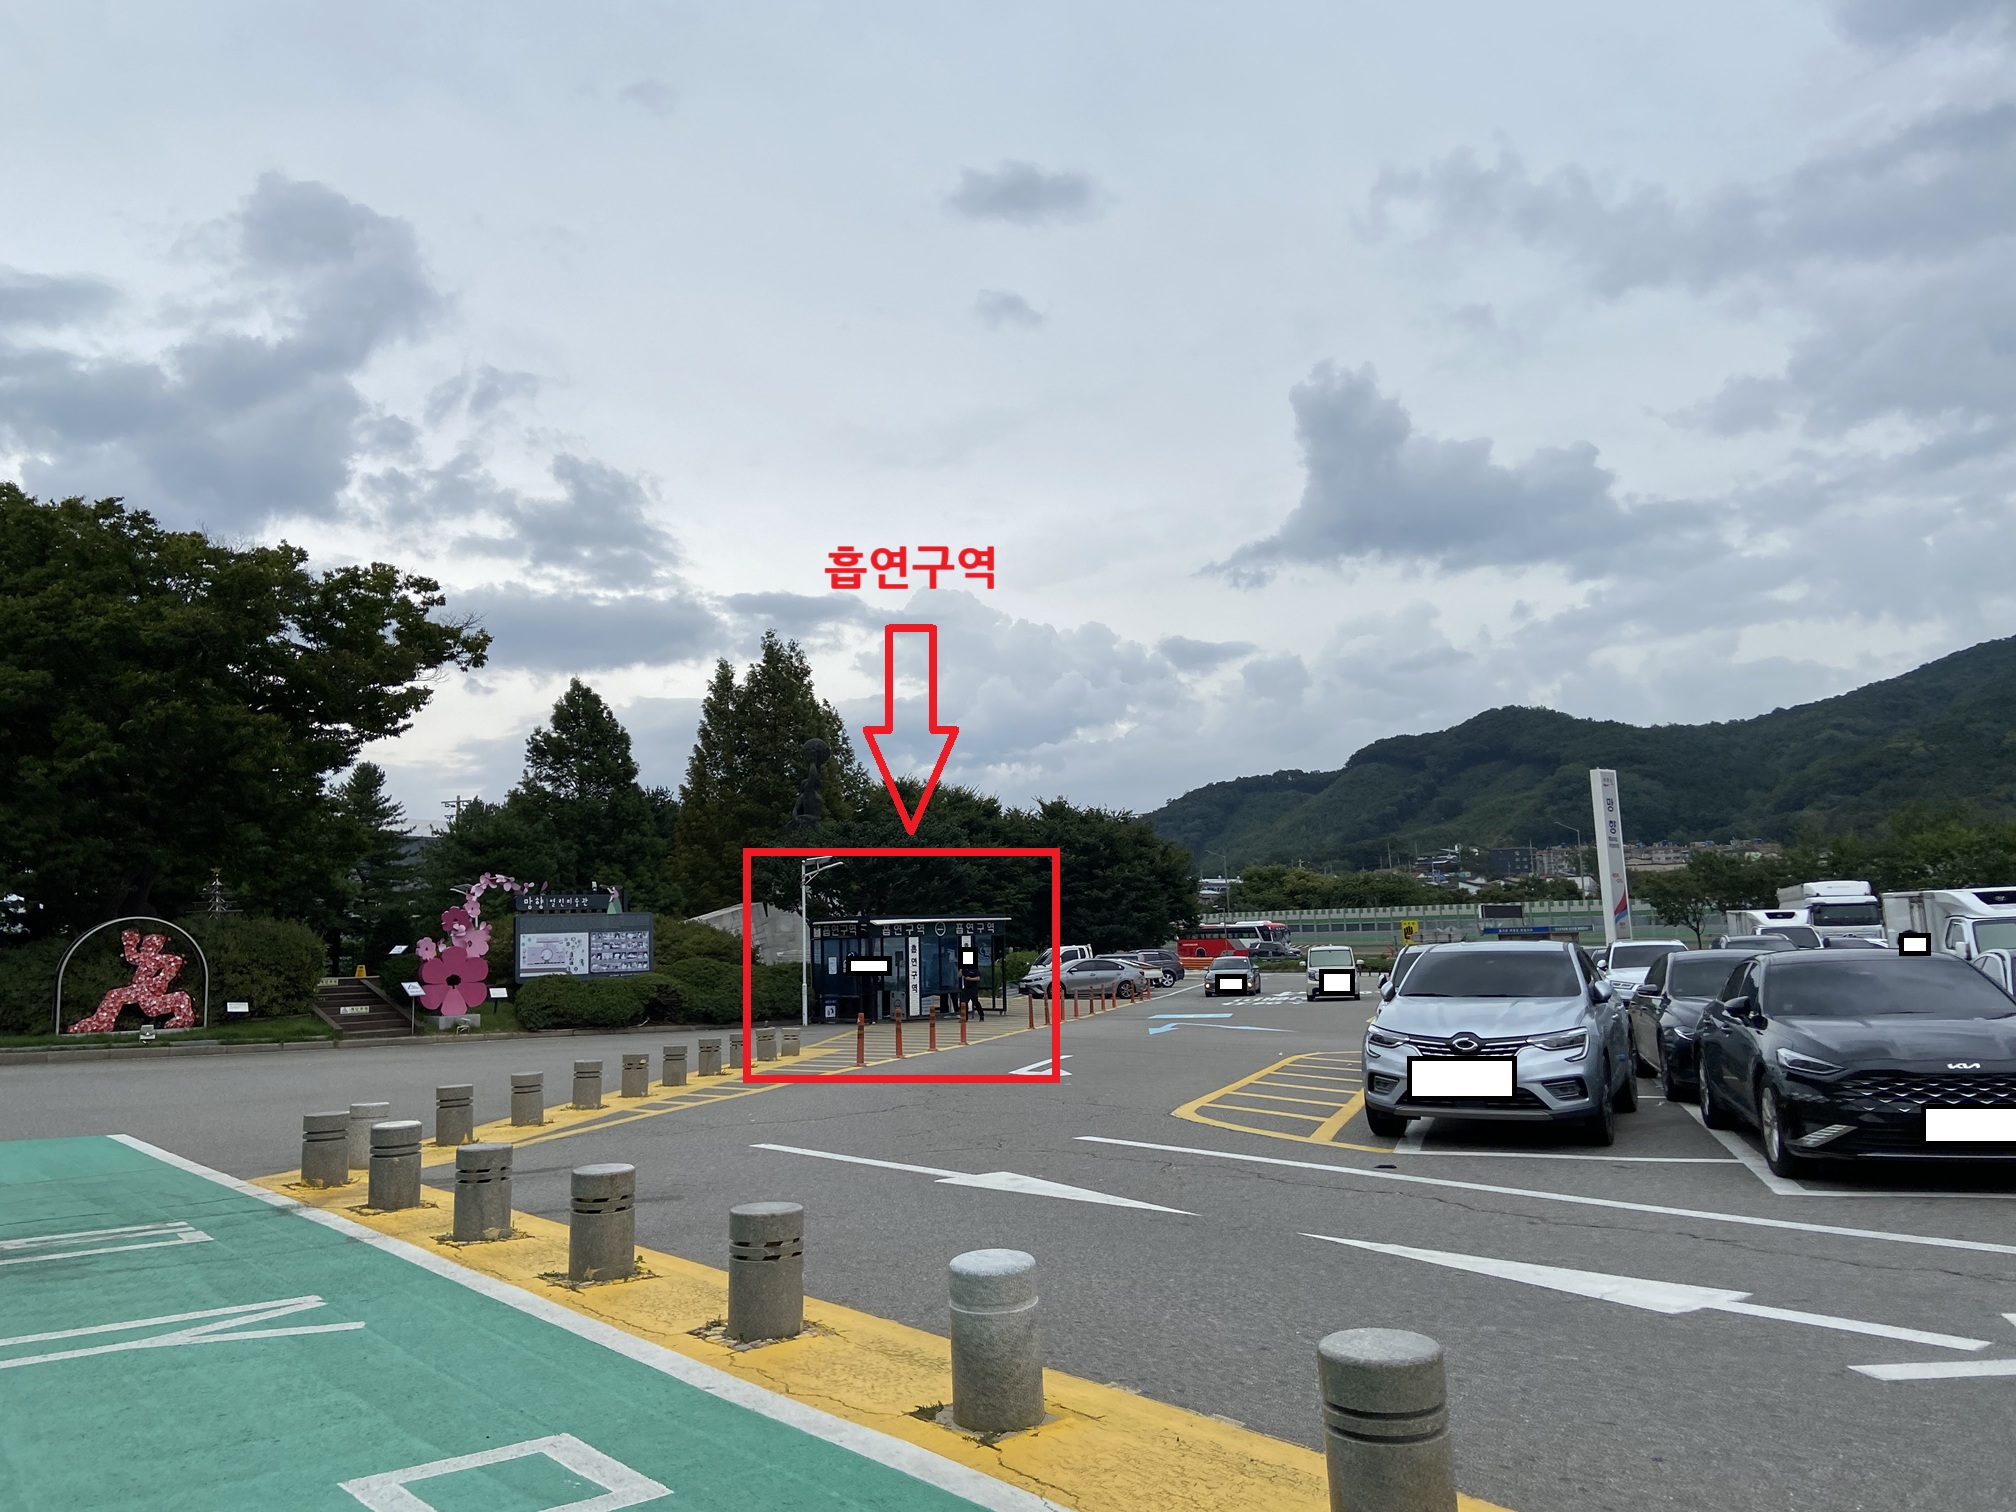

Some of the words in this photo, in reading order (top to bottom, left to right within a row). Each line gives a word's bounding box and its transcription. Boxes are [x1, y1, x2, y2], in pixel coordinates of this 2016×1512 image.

[1606, 797, 1617, 835] 망향
[523, 896, 544, 910] 망향
[822, 924, 857, 937] 흡연구역
[882, 923, 925, 936] 흡연구역
[955, 922, 995, 934] 흡연구역
